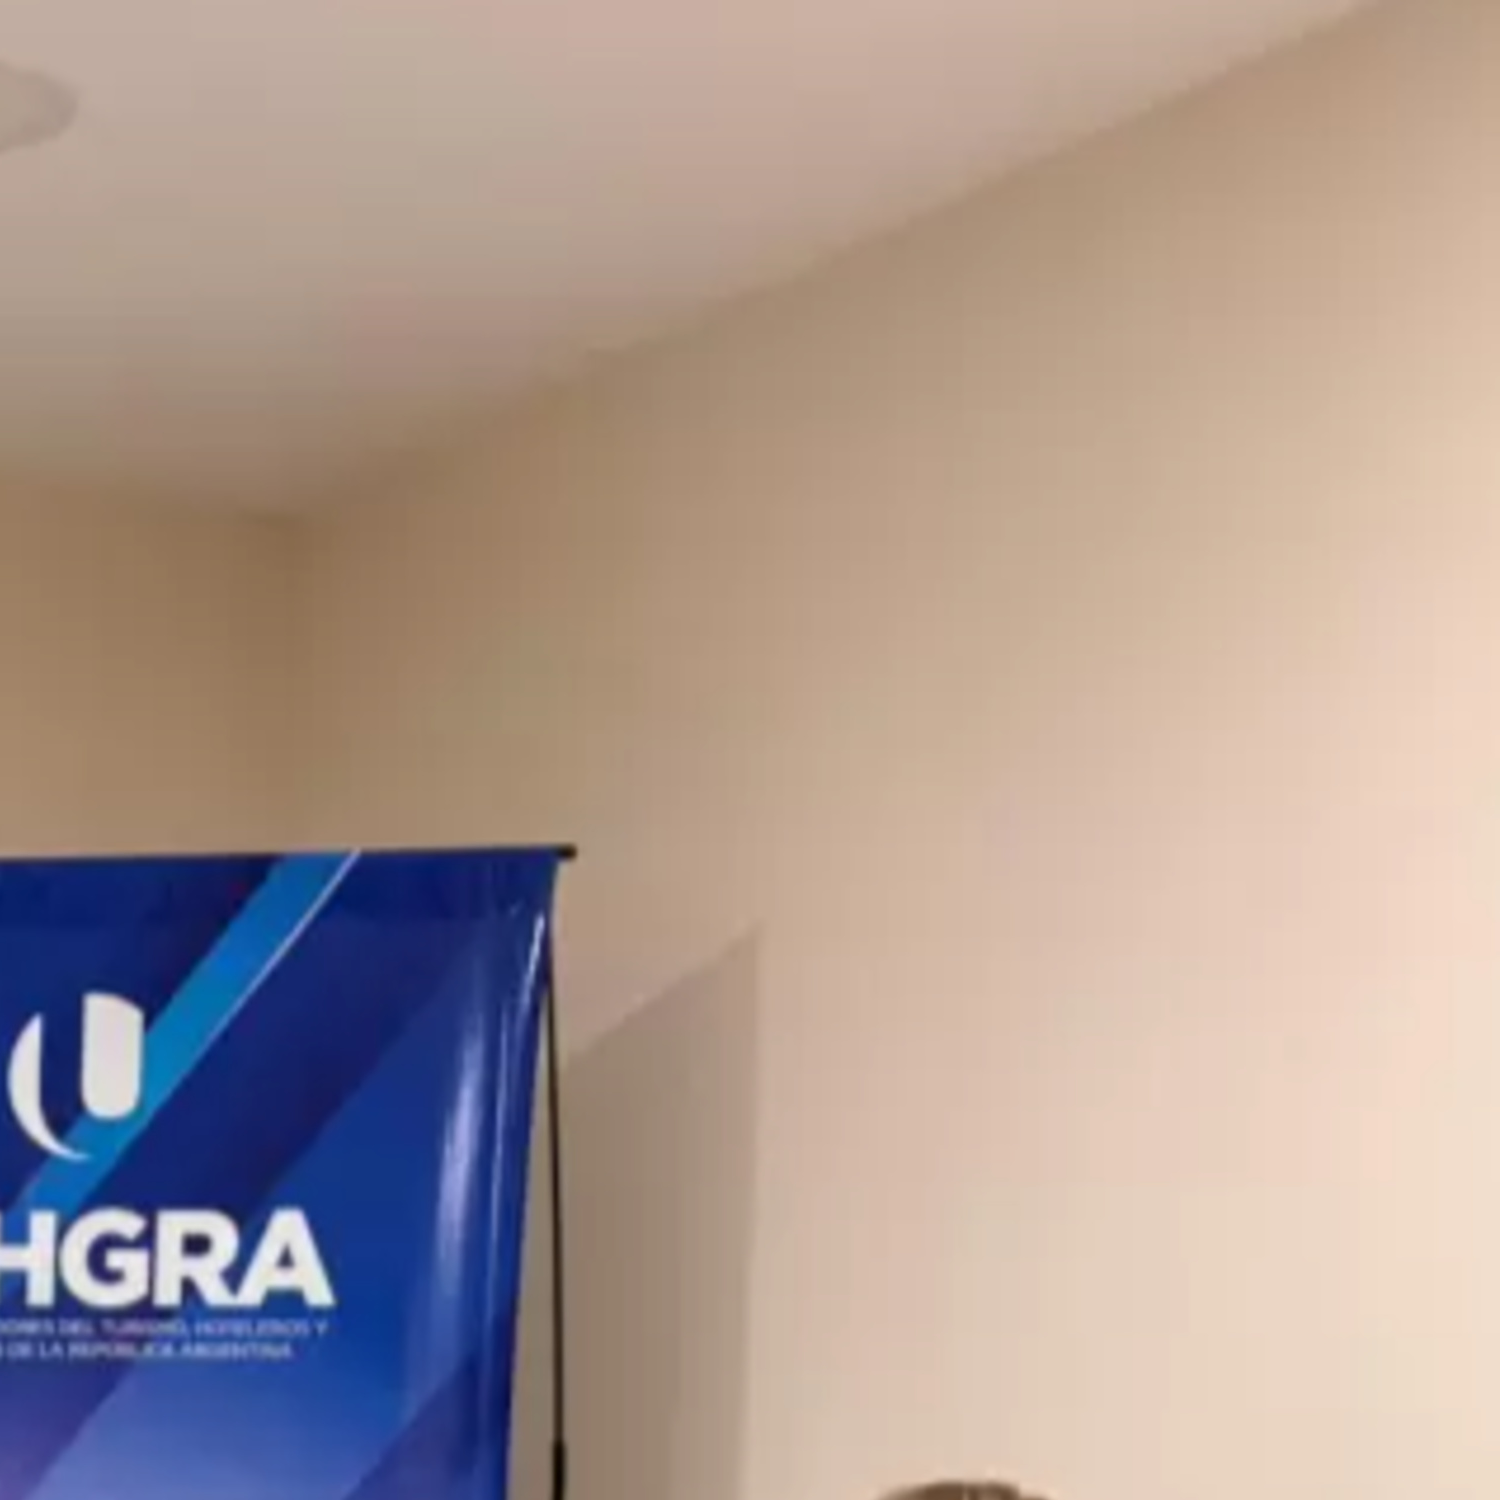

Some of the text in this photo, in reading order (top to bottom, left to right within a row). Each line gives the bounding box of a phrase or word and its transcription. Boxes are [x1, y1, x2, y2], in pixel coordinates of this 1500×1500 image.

[60, 1317, 95, 1337] DEL
[8, 1340, 32, 1359] DE
[39, 1340, 63, 1359] LA
[182, 1339, 294, 1359] ARGENTINA
